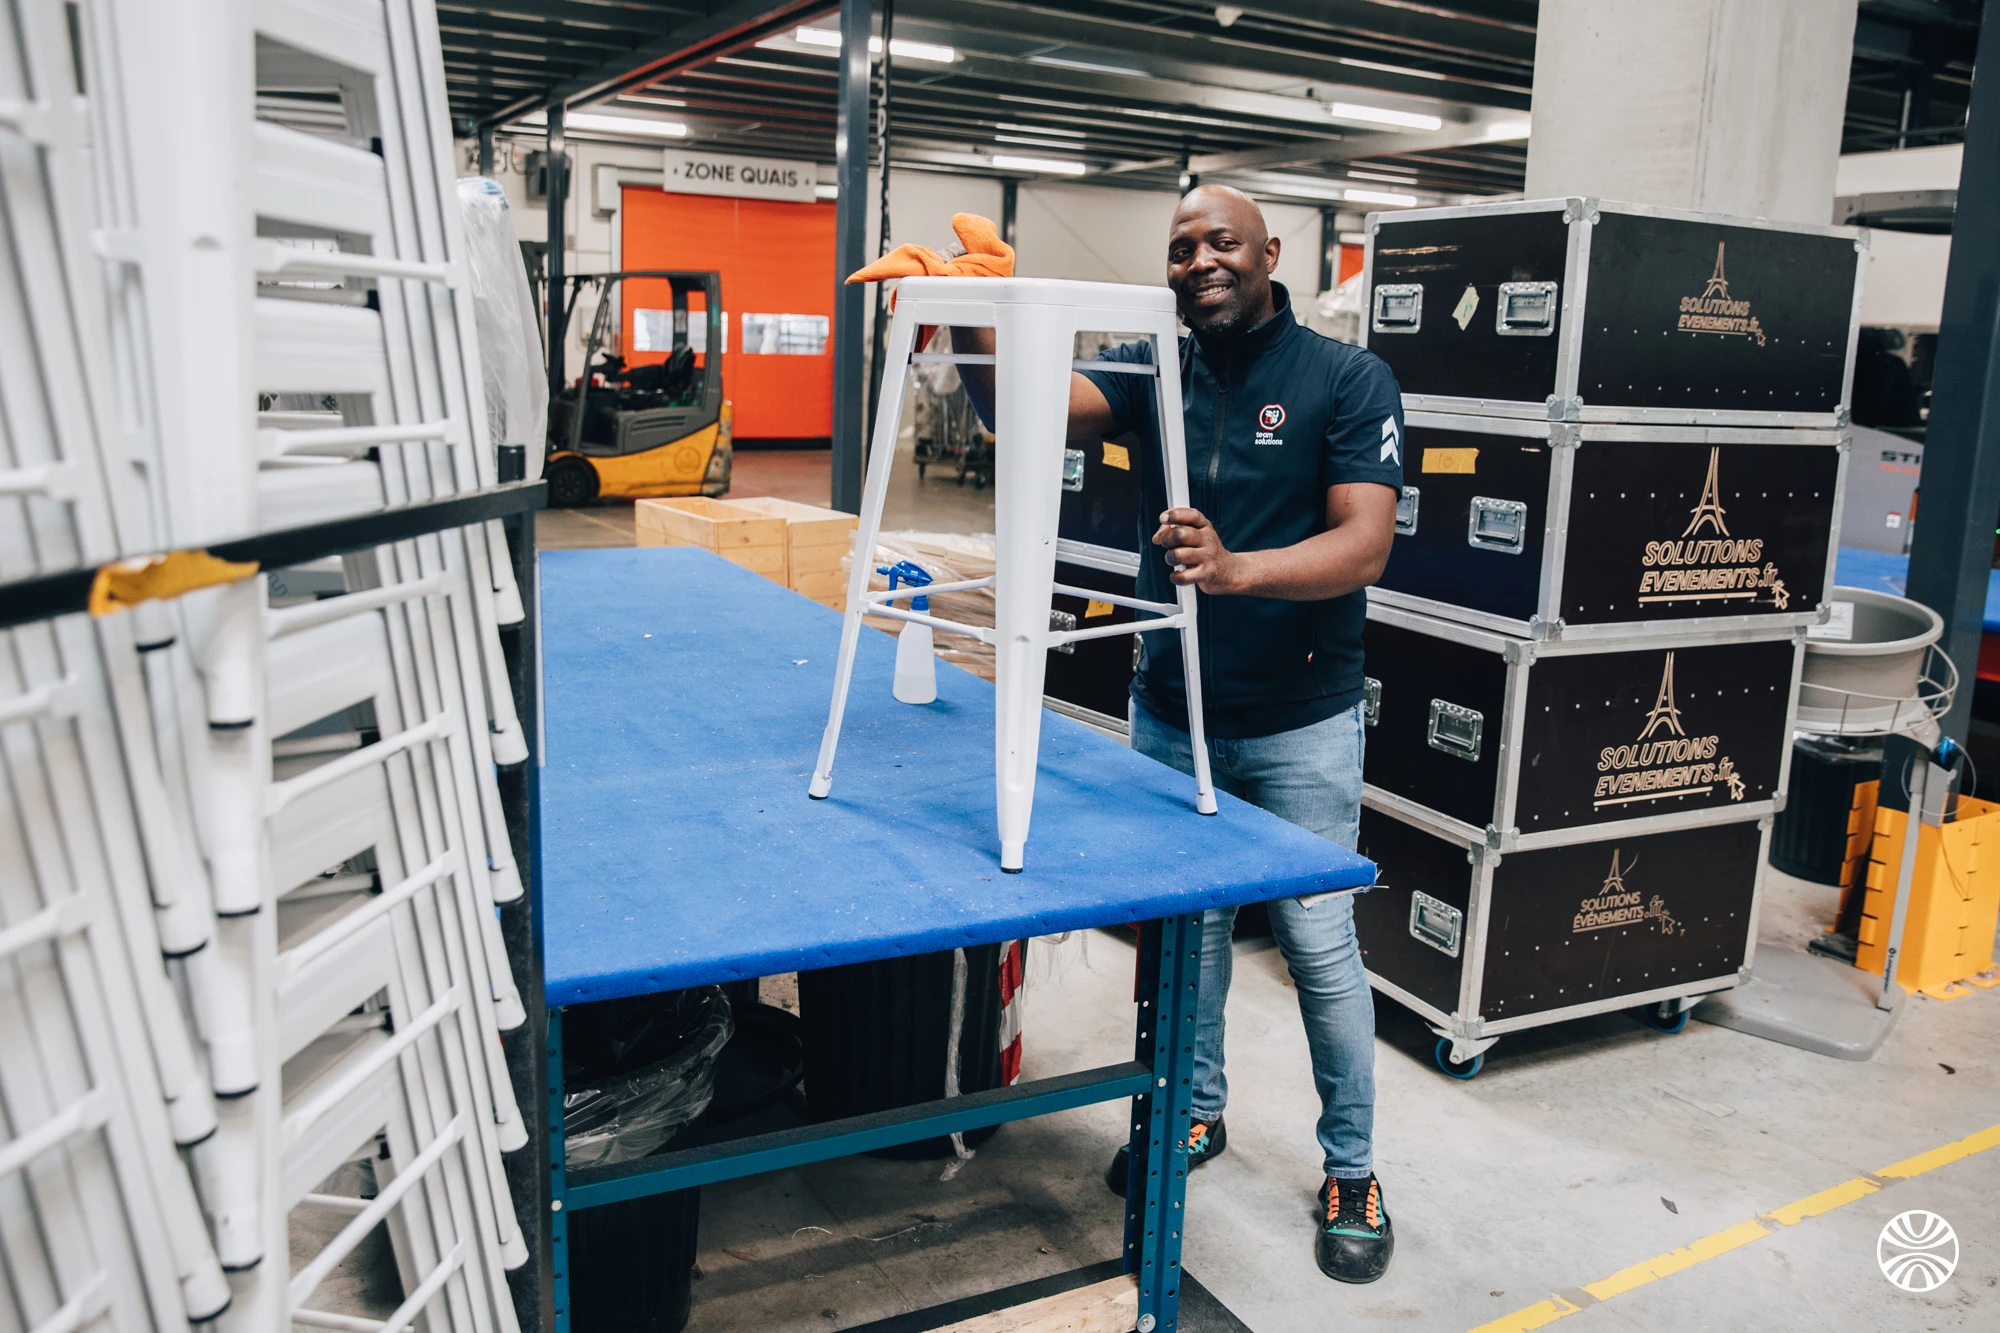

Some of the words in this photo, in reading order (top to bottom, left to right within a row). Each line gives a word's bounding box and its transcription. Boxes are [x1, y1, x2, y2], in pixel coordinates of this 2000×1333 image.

[685, 161, 736, 182] ZONE
[741, 166, 798, 188] QUAIS
[1679, 296, 1750, 316] SOLUTIONS
[1254, 437, 1283, 446] solutions
[1255, 431, 1274, 440] team
[1642, 538, 1763, 566] SOLUTIONS
[1639, 562, 1778, 593] EVENEMENTS.fr
[1597, 735, 1719, 771] SOLUTIONS
[1593, 756, 1734, 797] EVENEMENTS.fr
[1580, 891, 1641, 913] SOLUTIONS
